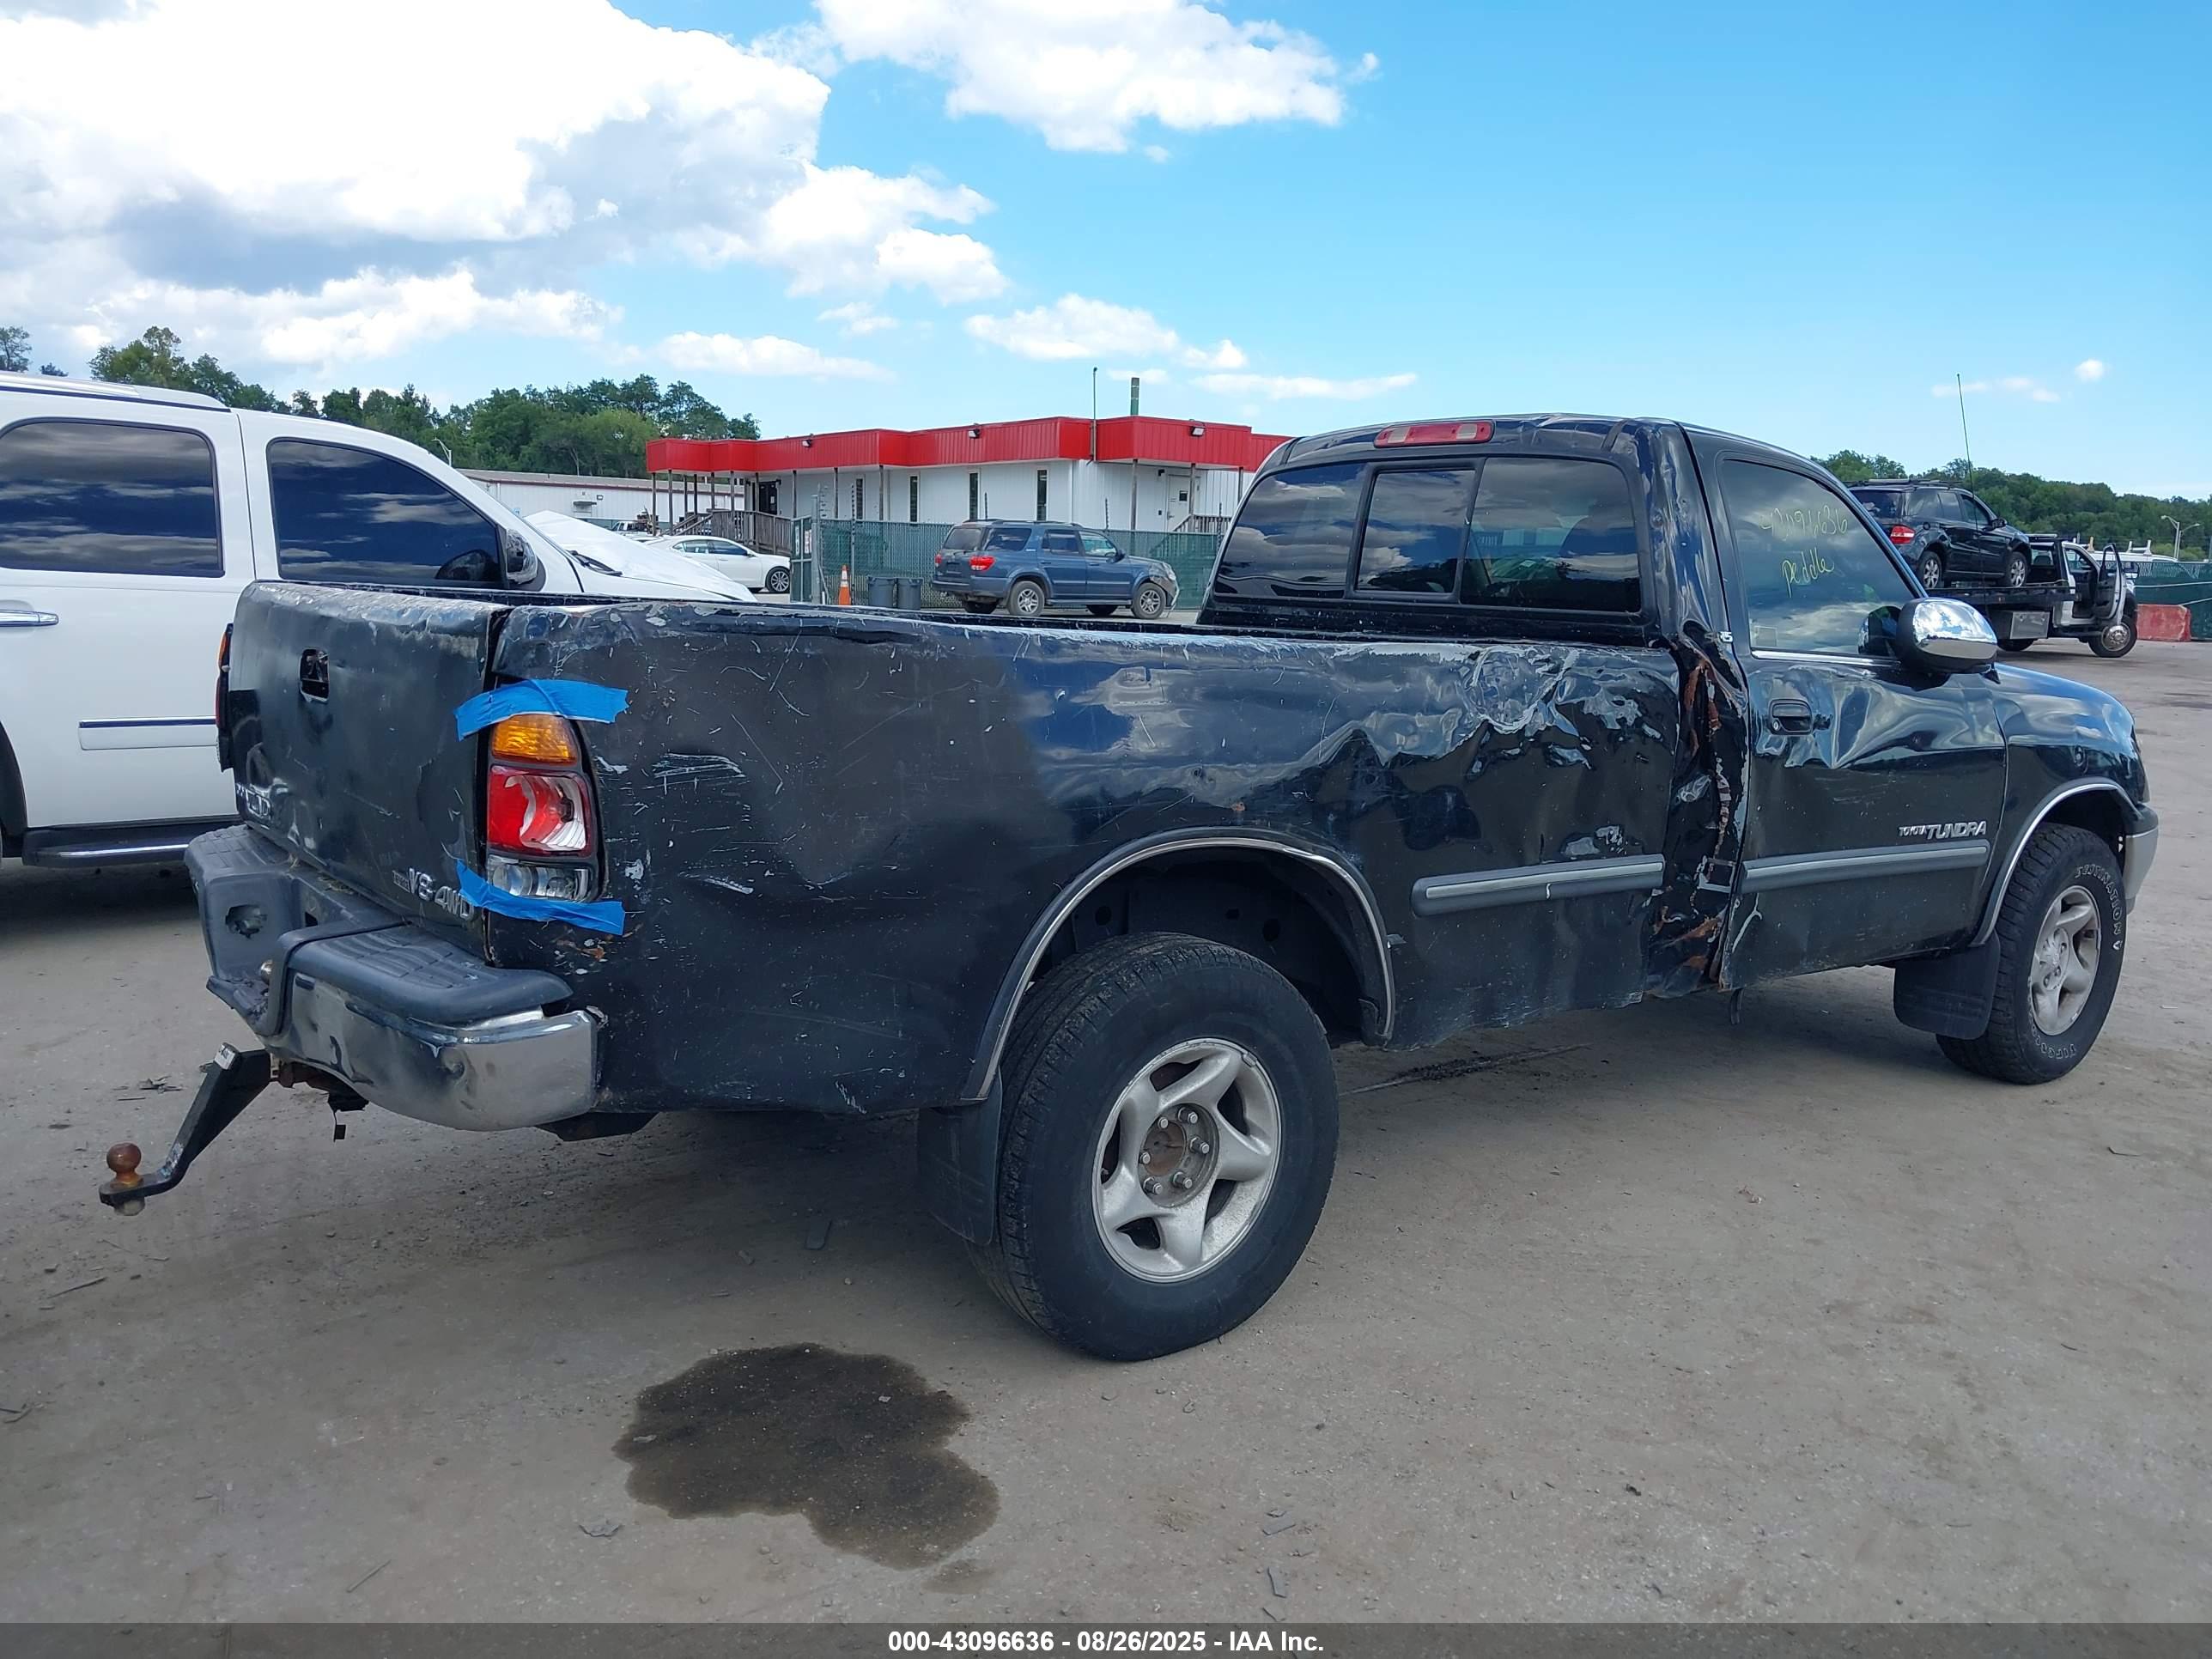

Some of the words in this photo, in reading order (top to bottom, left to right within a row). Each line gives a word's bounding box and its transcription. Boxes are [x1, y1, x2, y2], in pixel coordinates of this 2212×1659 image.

[1926, 821, 1986, 840] TUNDRA
[409, 867, 433, 902] V8
[434, 885, 475, 921] 4WD
